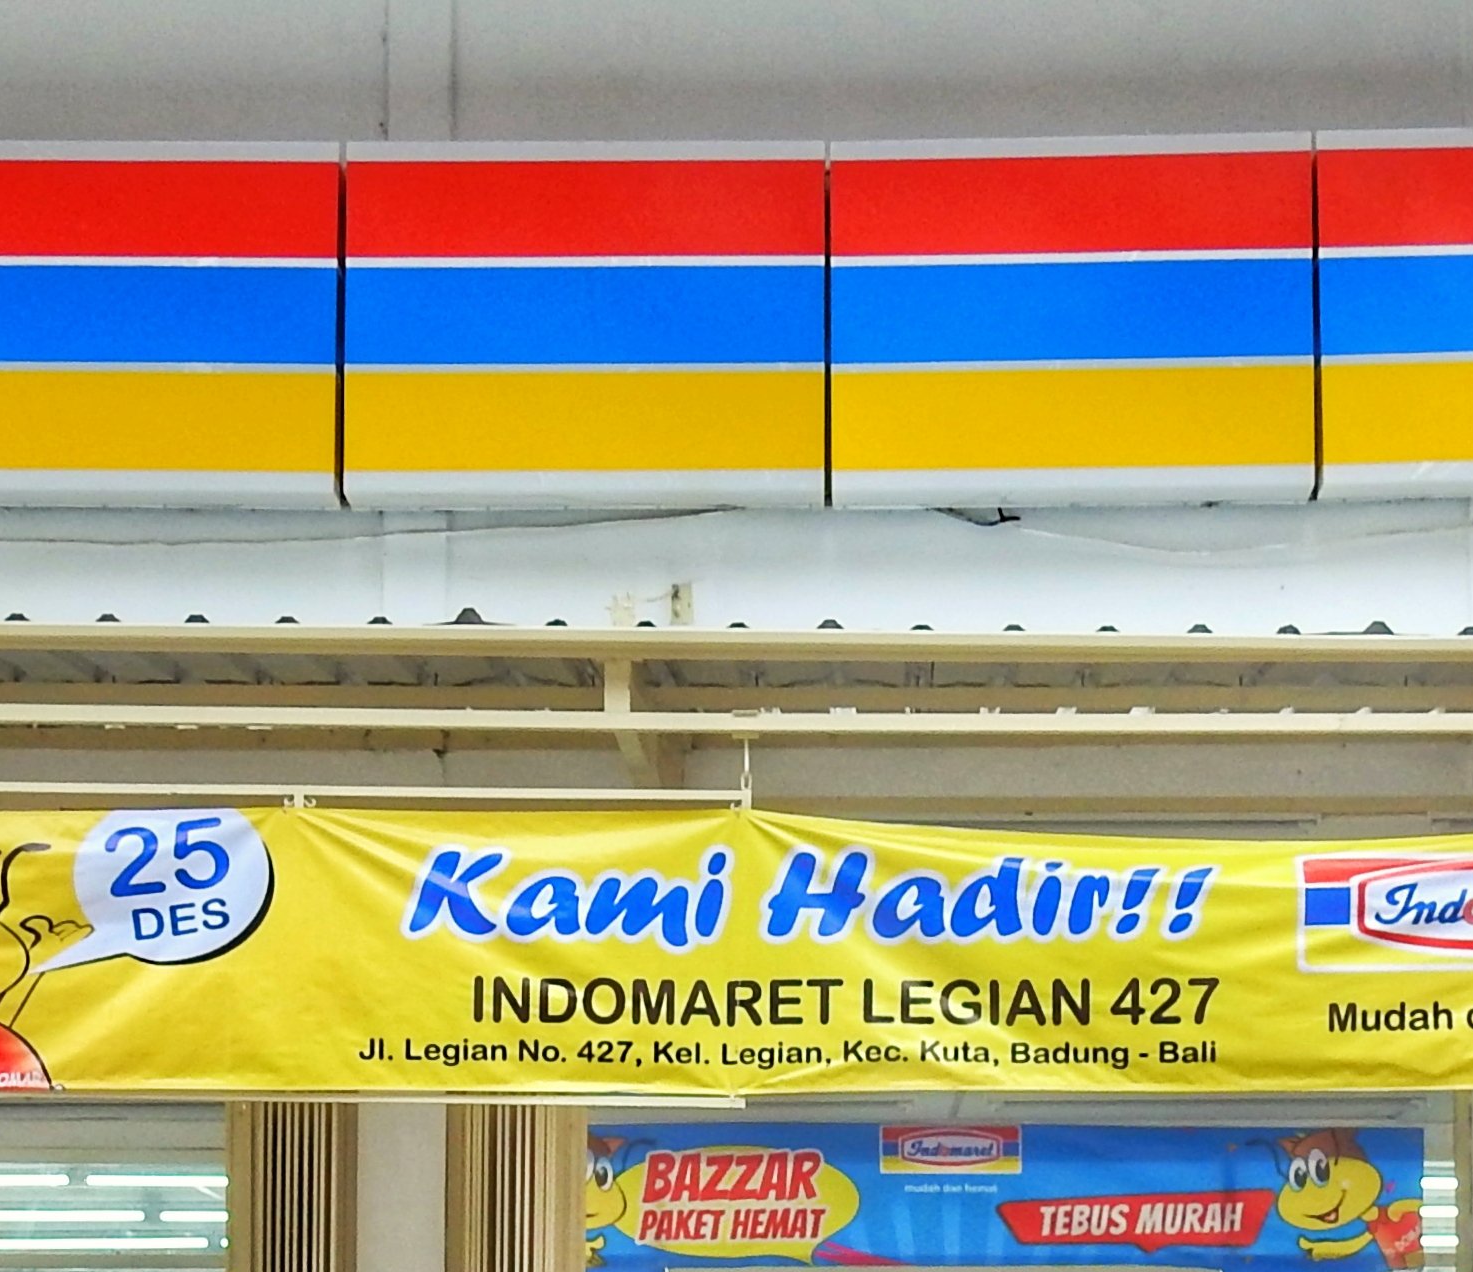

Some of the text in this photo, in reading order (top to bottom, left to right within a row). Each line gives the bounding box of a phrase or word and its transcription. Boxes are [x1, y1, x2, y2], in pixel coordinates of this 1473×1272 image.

[105, 818, 231, 898] 25
[407, 850, 1217, 945] Kami Hadir!!
[132, 898, 231, 942] DES
[473, 976, 1219, 1028] INDOMARET LEGIAN 427
[1328, 1001, 1454, 1033] Mudah
[404, 1039, 508, 1068] Legian
[518, 1040, 567, 1063] No.
[577, 1040, 643, 1069] 427,
[653, 1041, 711, 1065] Kel.
[722, 1041, 831, 1071] Legian,
[843, 1040, 909, 1065] Kec.
[919, 1041, 1000, 1070] Kuta,
[1010, 1040, 1130, 1072] Badung
[1158, 1040, 1217, 1065] Bali
[906, 1139, 995, 1158] Indomaret
[642, 1151, 825, 1205] BAZZAR
[639, 1208, 827, 1242] PAKET HEMAT
[1039, 1201, 1245, 1237] TEBUS MURAH
